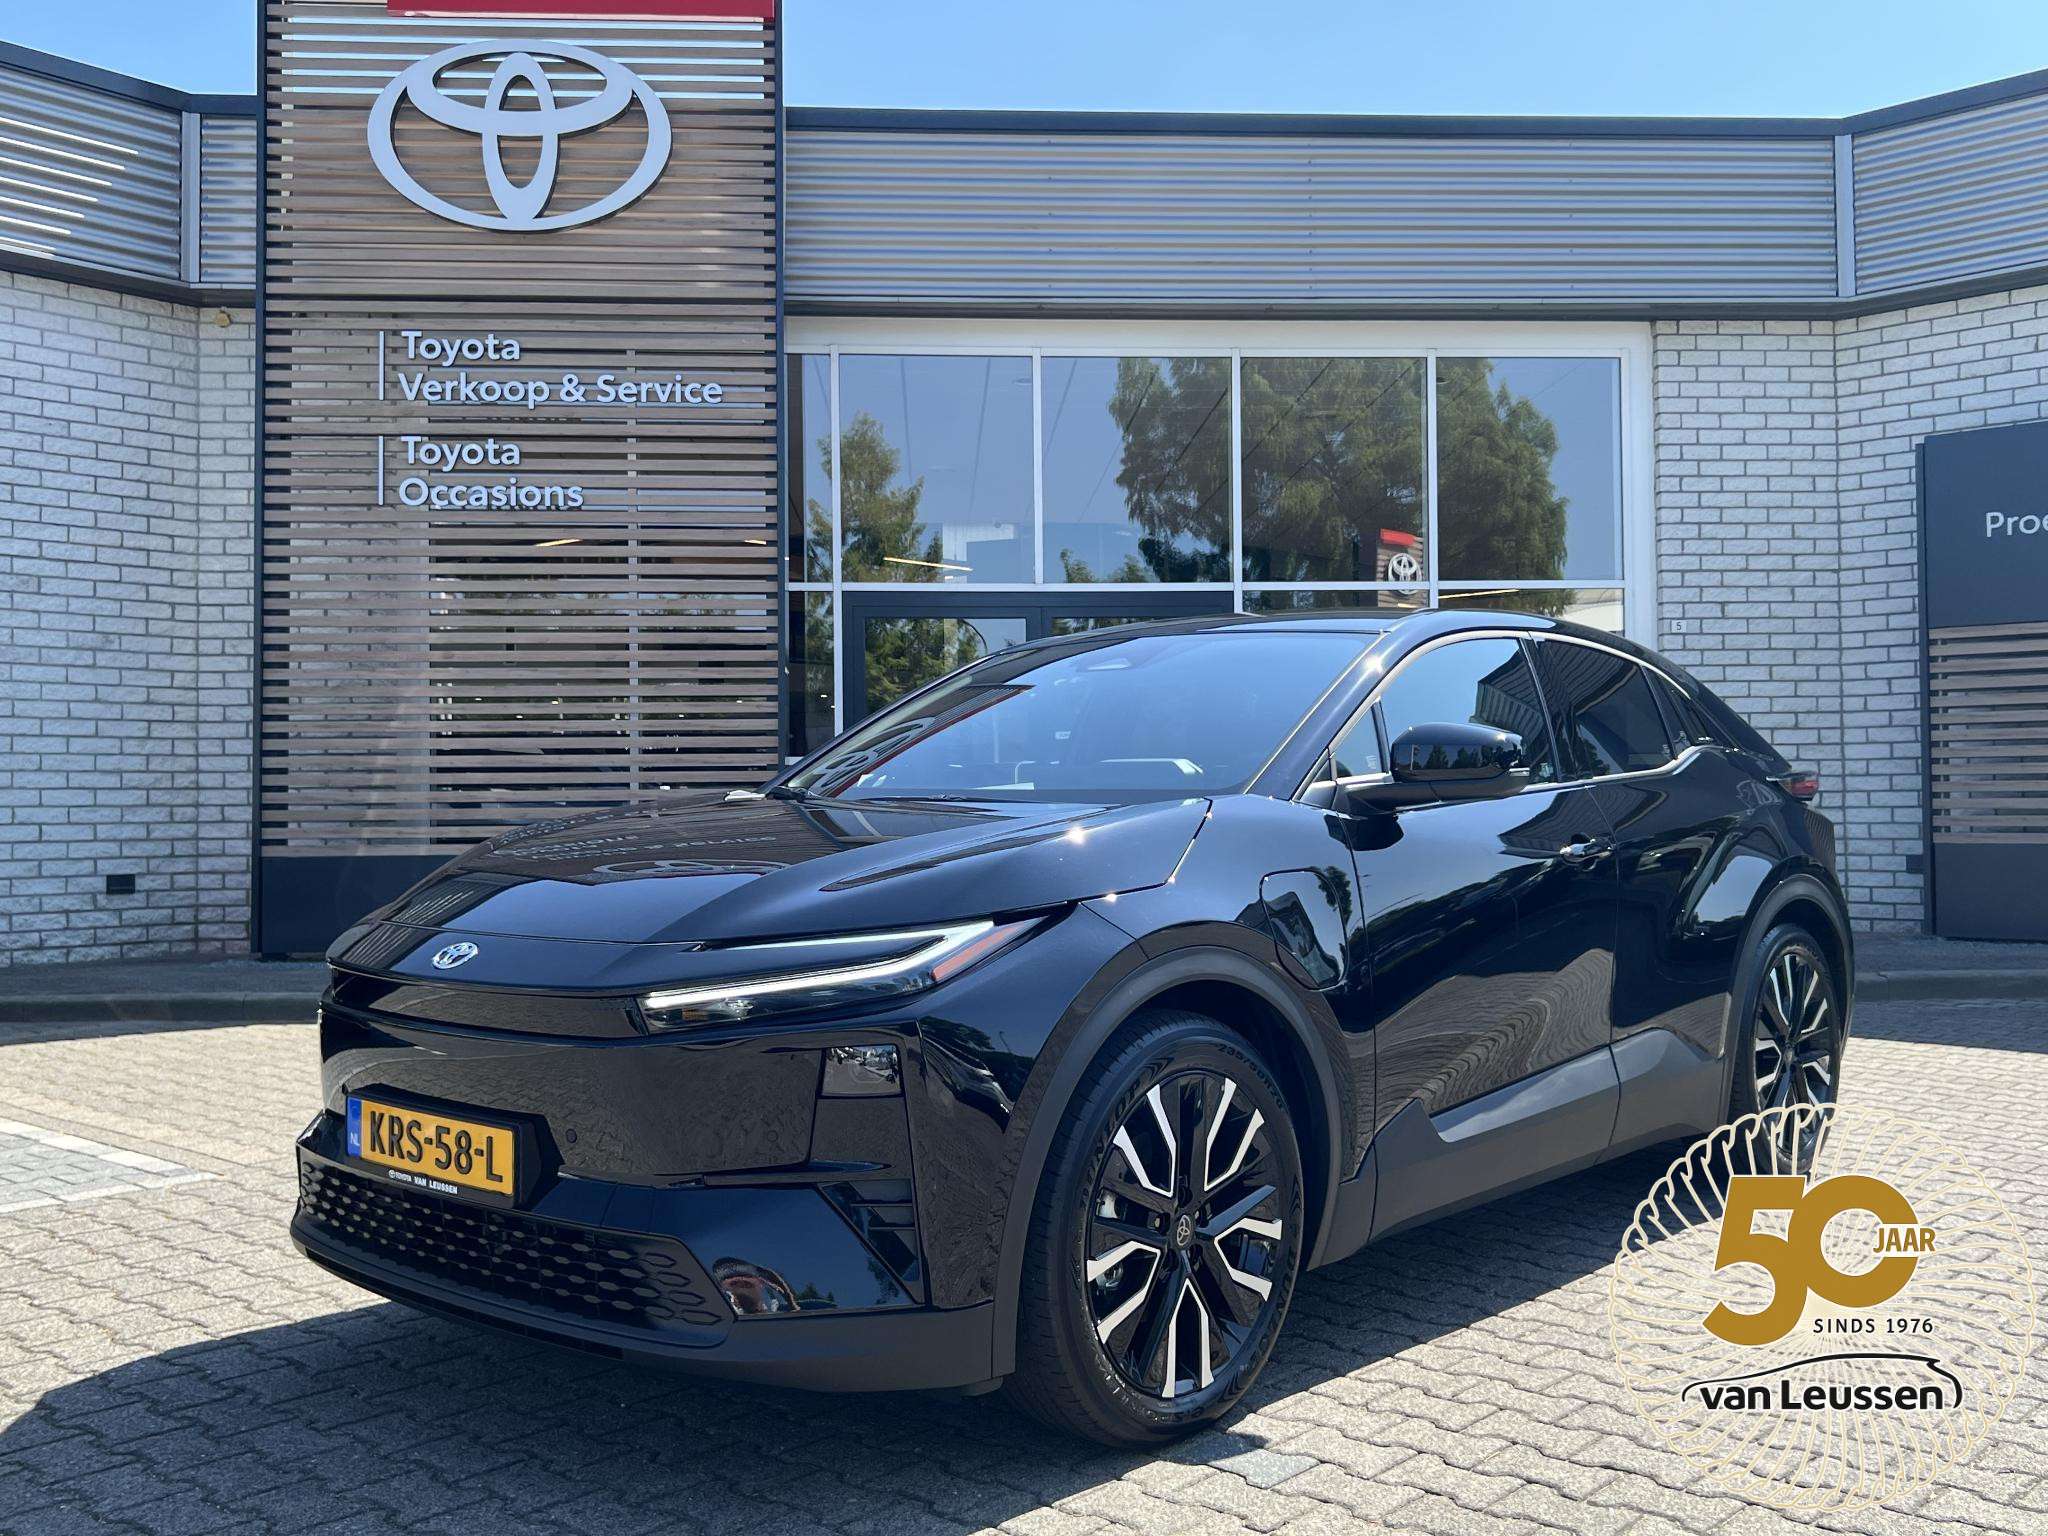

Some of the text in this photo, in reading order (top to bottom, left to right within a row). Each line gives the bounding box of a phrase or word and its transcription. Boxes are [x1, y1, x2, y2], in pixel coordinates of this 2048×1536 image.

[401, 331, 520, 367] Toyota
[398, 372, 723, 409] Verkoop & Service
[401, 436, 520, 471] Toyota
[399, 477, 584, 507] Occasions
[350, 1132, 360, 1146] NL
[370, 1110, 503, 1182] KRS-58-L
[414, 1176, 427, 1187] VAN
[429, 1180, 458, 1195] LEUSSEN
